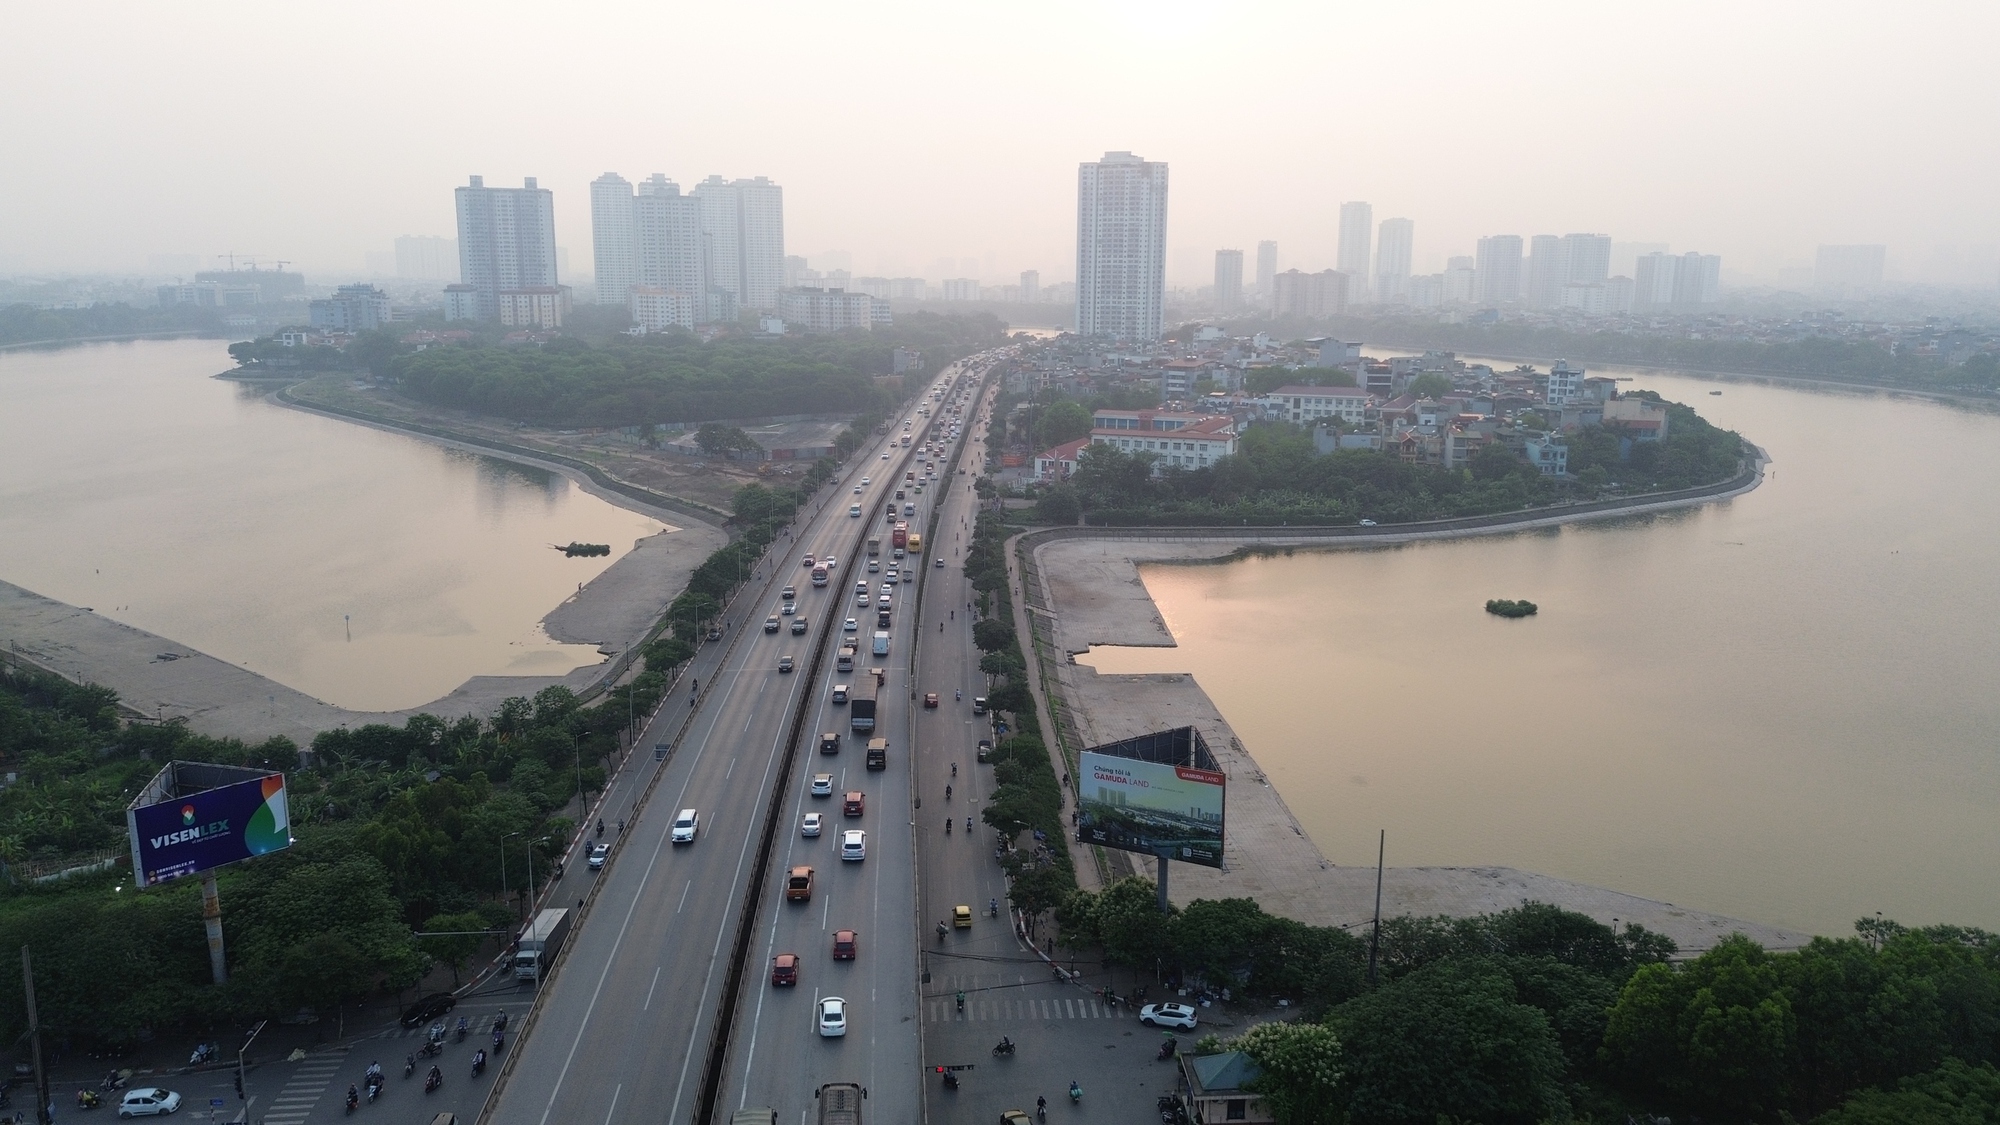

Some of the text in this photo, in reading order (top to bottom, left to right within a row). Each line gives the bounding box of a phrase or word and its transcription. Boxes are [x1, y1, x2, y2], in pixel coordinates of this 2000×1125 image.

[1093, 765, 1113, 775] Chúng
[1181, 772, 1204, 780] GAMUDA
[1093, 772, 1150, 788] GAMUDA LAND
[150, 819, 230, 849] VISENLEX
